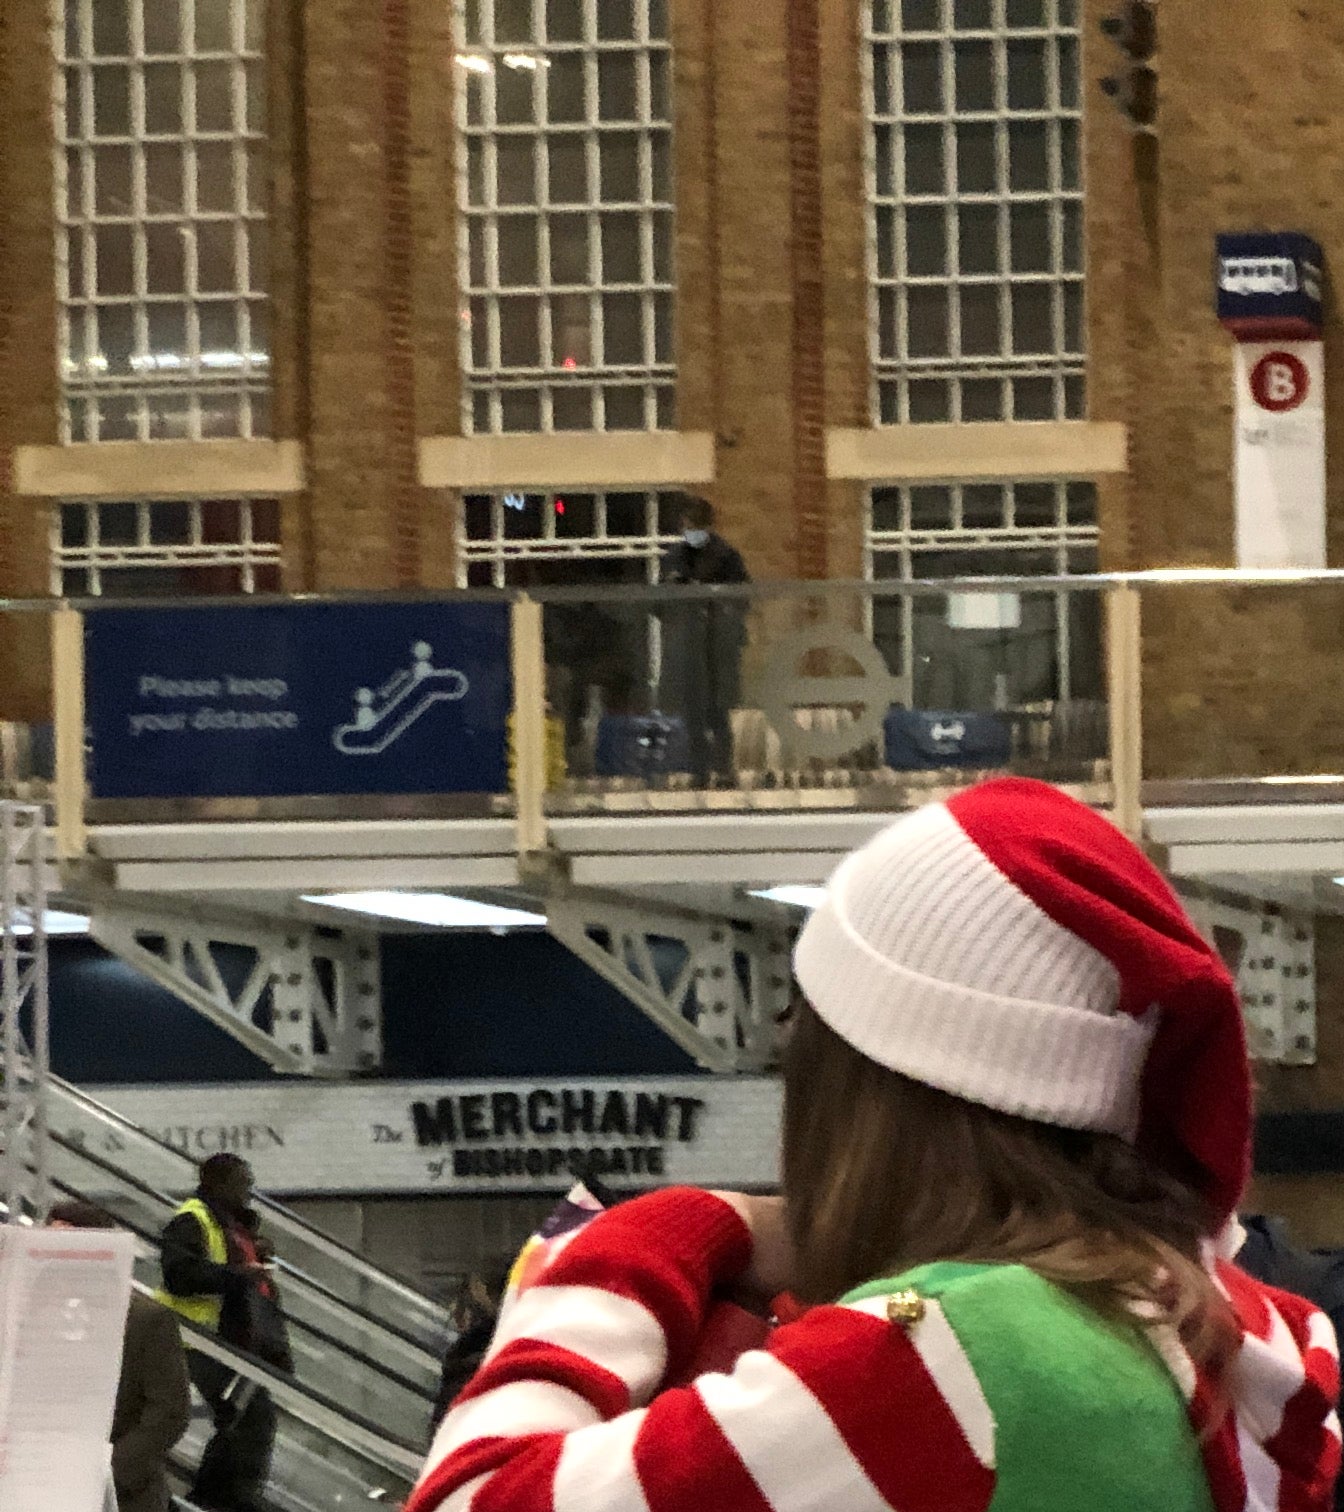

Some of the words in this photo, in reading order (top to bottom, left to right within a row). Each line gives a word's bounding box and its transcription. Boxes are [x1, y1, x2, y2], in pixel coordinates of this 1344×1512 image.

[1266, 363, 1296, 401] B
[140, 675, 222, 697] Please
[226, 675, 289, 700] keep
[130, 713, 187, 736] your
[192, 706, 299, 730] distance
[410, 1088, 704, 1146] MERCHANT
